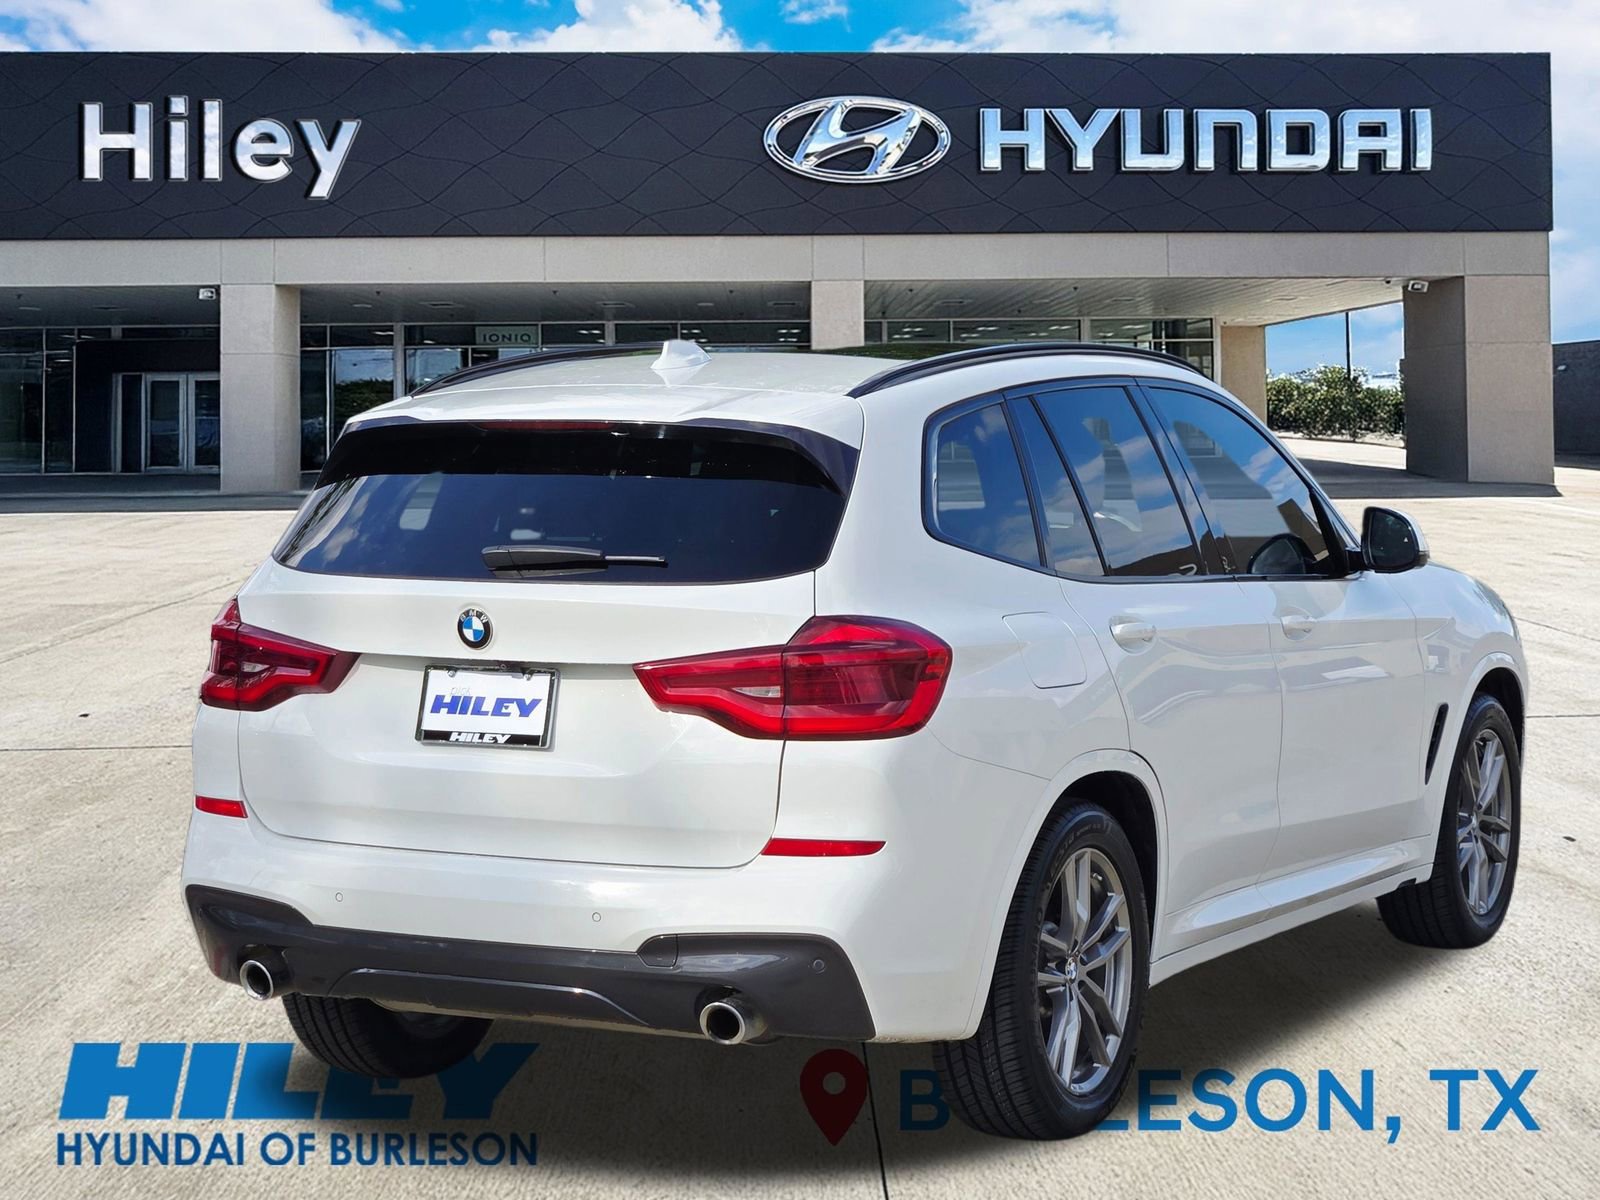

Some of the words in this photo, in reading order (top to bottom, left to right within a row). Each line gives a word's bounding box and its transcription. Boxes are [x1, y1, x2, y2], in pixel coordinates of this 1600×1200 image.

[80, 95, 362, 200] Hiley
[978, 107, 1433, 173] HYUNDAI
[483, 333, 532, 343] IONIQ
[460, 608, 489, 624] BMW
[430, 694, 544, 718] HILEY
[449, 732, 512, 744] HILEY
